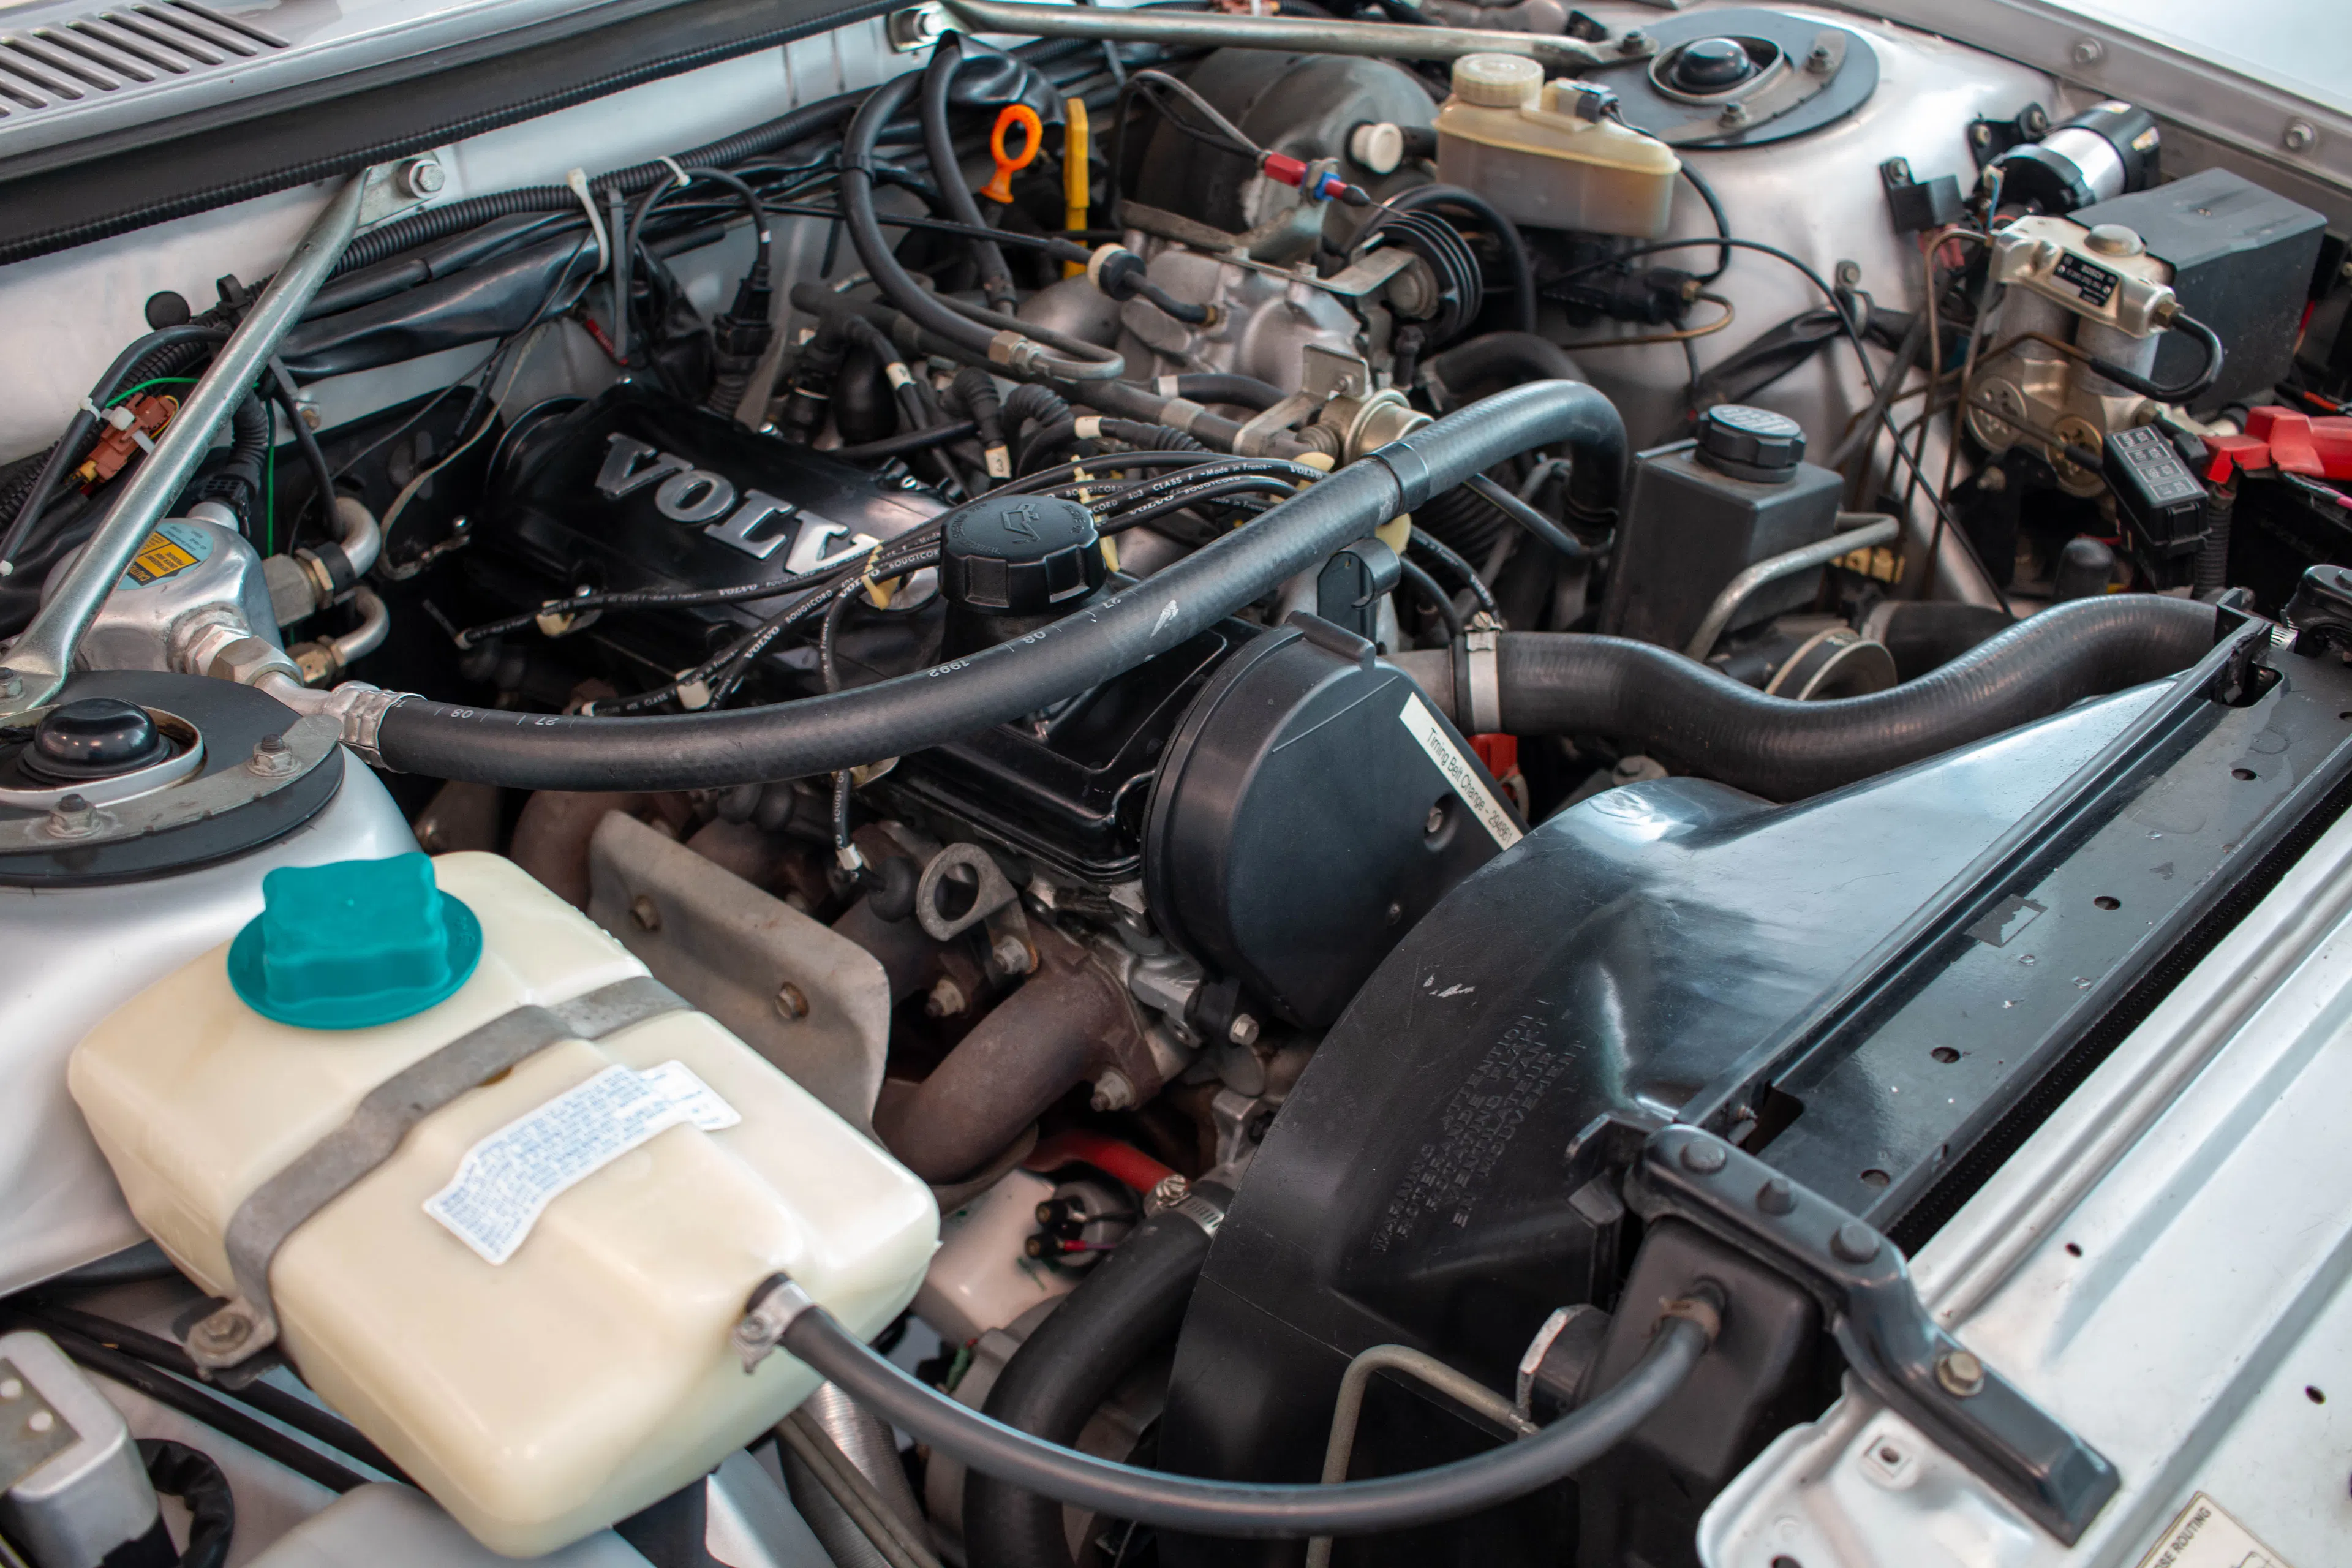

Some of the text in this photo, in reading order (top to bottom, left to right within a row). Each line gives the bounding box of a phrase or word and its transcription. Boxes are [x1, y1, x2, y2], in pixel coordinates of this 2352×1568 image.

[1128, 494, 1175, 515] VOLVO
[1152, 476, 1182, 491] CLASS
[1232, 463, 1240, 472] in
[1288, 464, 1324, 480] VOLVO
[718, 583, 759, 597] VOLVO
[889, 548, 940, 569] BOUGICOR
[744, 625, 781, 660] VOLVO
[785, 589, 834, 624] BOUGICORD
[927, 659, 971, 678] 1992
[1427, 726, 1450, 766] Timing
[1448, 755, 1463, 783] Belt
[1460, 774, 1486, 812] Change
[1488, 810, 1513, 846] 294861
[1370, 1143, 1436, 1255] WARNING
[1440, 1015, 1534, 1133] ATTENTION
[1425, 1041, 1548, 1212] ROTATING FAN
[1441, 1051, 1558, 1206] VENTILATEUR
[1449, 1039, 1588, 1231] EN MOUVEMENT
[1396, 1094, 1487, 1238] ROTERANDE
[2171, 1507, 2212, 1553] ROUTING
